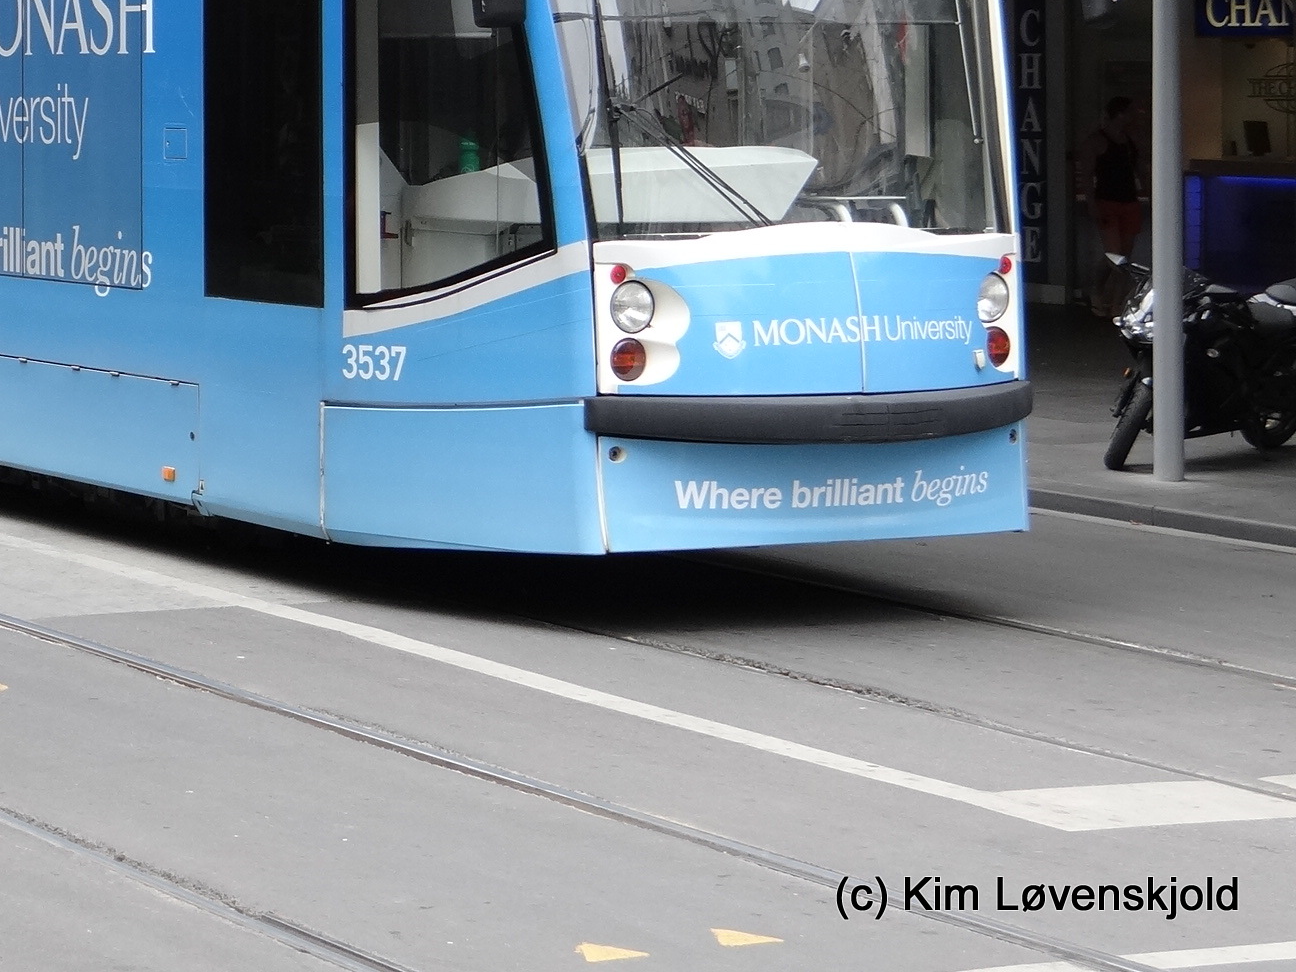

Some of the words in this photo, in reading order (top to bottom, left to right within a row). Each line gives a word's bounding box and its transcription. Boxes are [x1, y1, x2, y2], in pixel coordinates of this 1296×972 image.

[1018, 8, 1043, 264] CHANGE
[70, 224, 153, 298] begins
[752, 315, 882, 347] MONASH
[883, 314, 973, 347] University
[342, 343, 407, 381] 3537
[674, 479, 783, 510] Where
[791, 476, 904, 510] brilliant
[910, 469, 989, 507] begins
